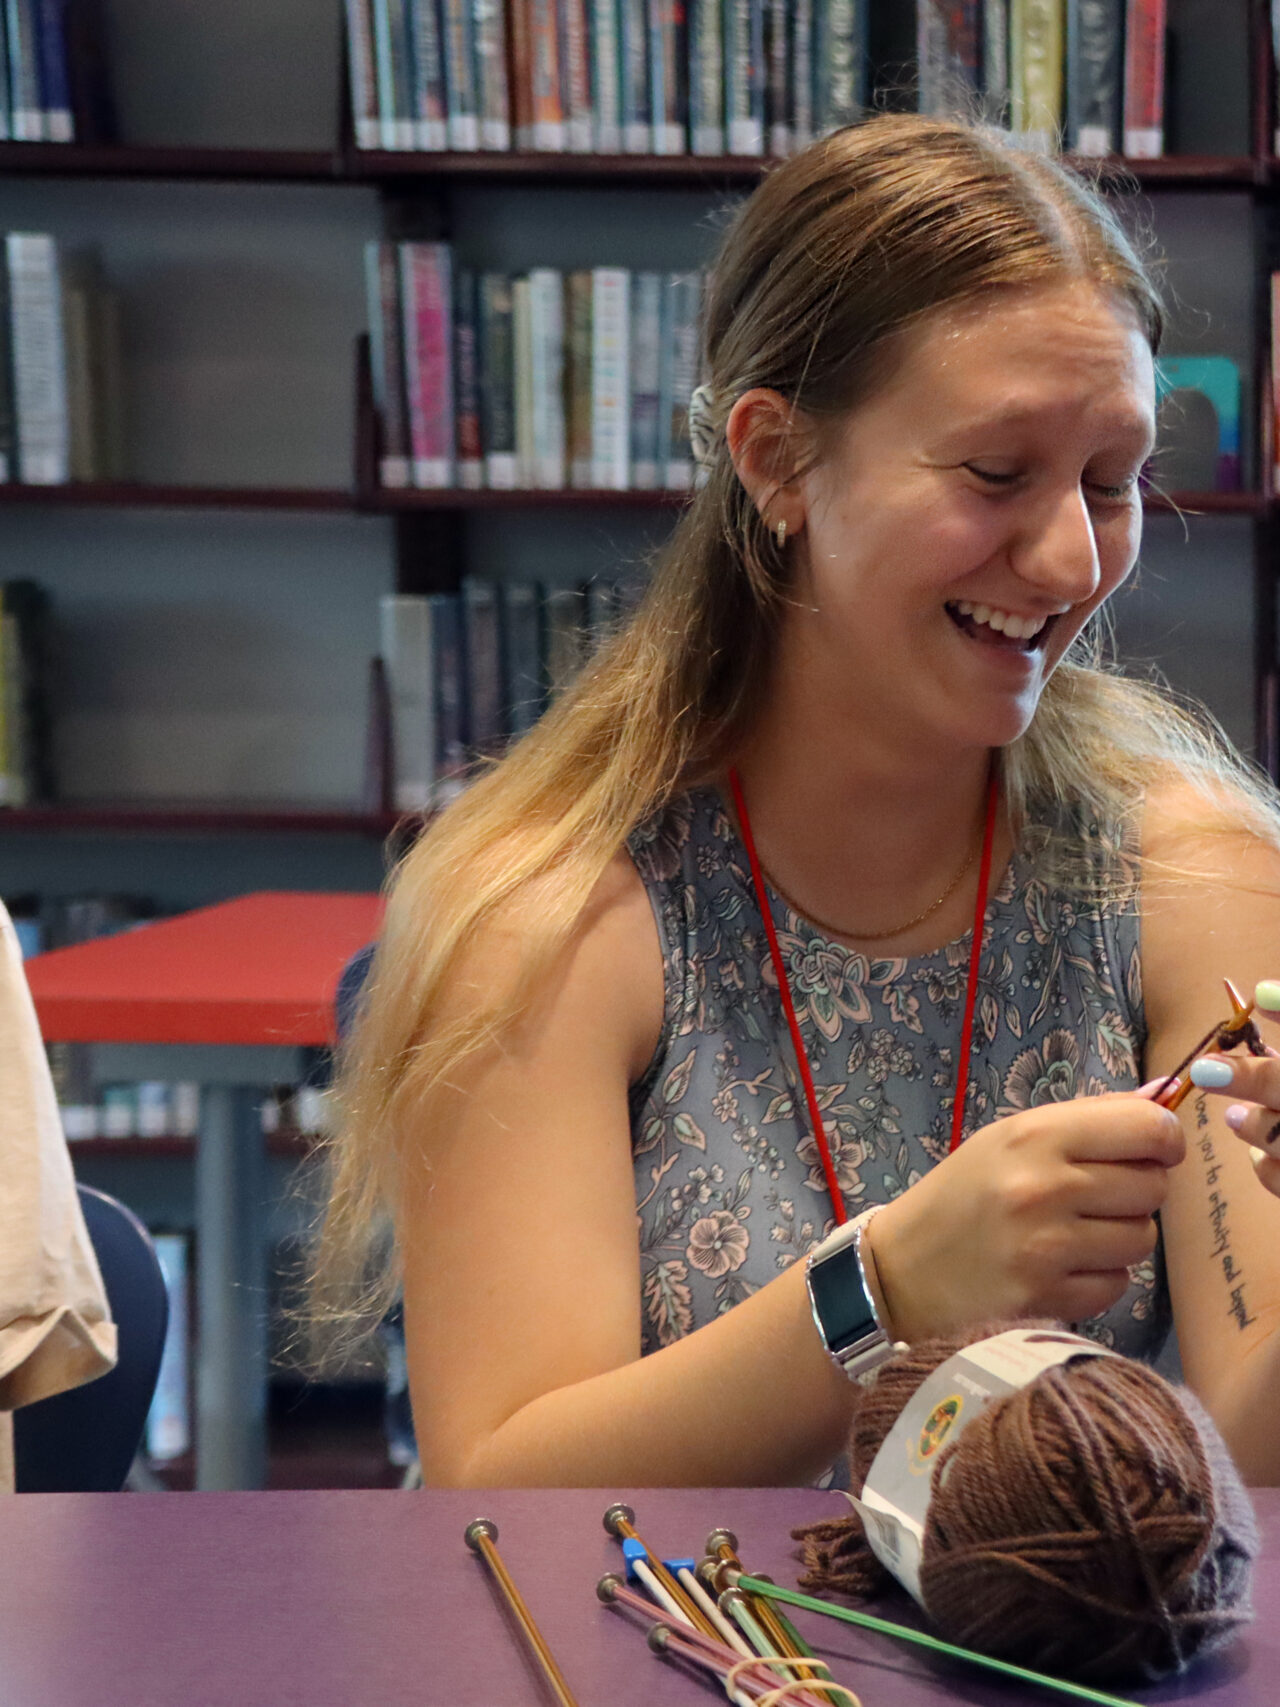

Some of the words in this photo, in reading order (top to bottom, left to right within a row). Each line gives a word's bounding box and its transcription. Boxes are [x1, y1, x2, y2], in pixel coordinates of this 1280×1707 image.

[1195, 1092, 1209, 1129] love
[1196, 1133, 1216, 1162] you
[1206, 1164, 1223, 1186] to
[1209, 1190, 1231, 1258] infinity
[1223, 1255, 1242, 1284] and
